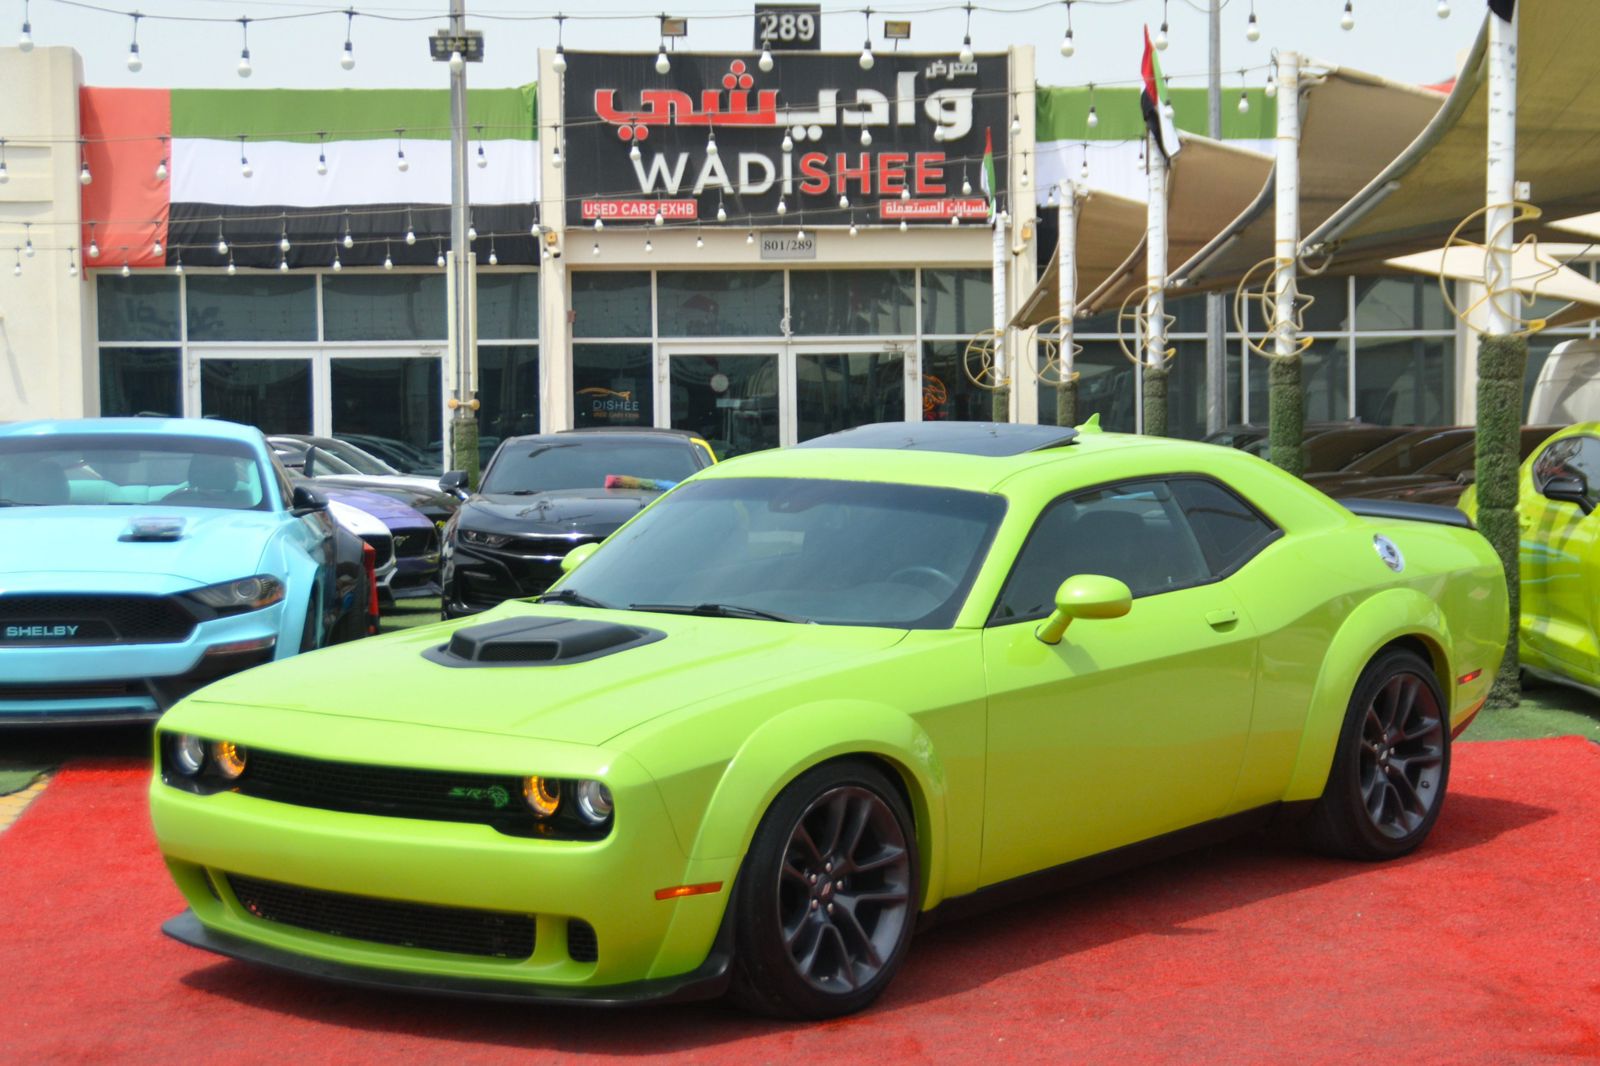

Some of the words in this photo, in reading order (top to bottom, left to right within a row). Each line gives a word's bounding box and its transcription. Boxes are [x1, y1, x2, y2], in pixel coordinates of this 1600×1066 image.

[760, 14, 815, 41] 289
[631, 151, 947, 195] WADISHEE
[584, 203, 618, 216] USED
[621, 203, 656, 216] CARS
[660, 203, 695, 216] EXHB
[764, 239, 813, 251] 801/289
[6, 626, 78, 636] SHELBY
